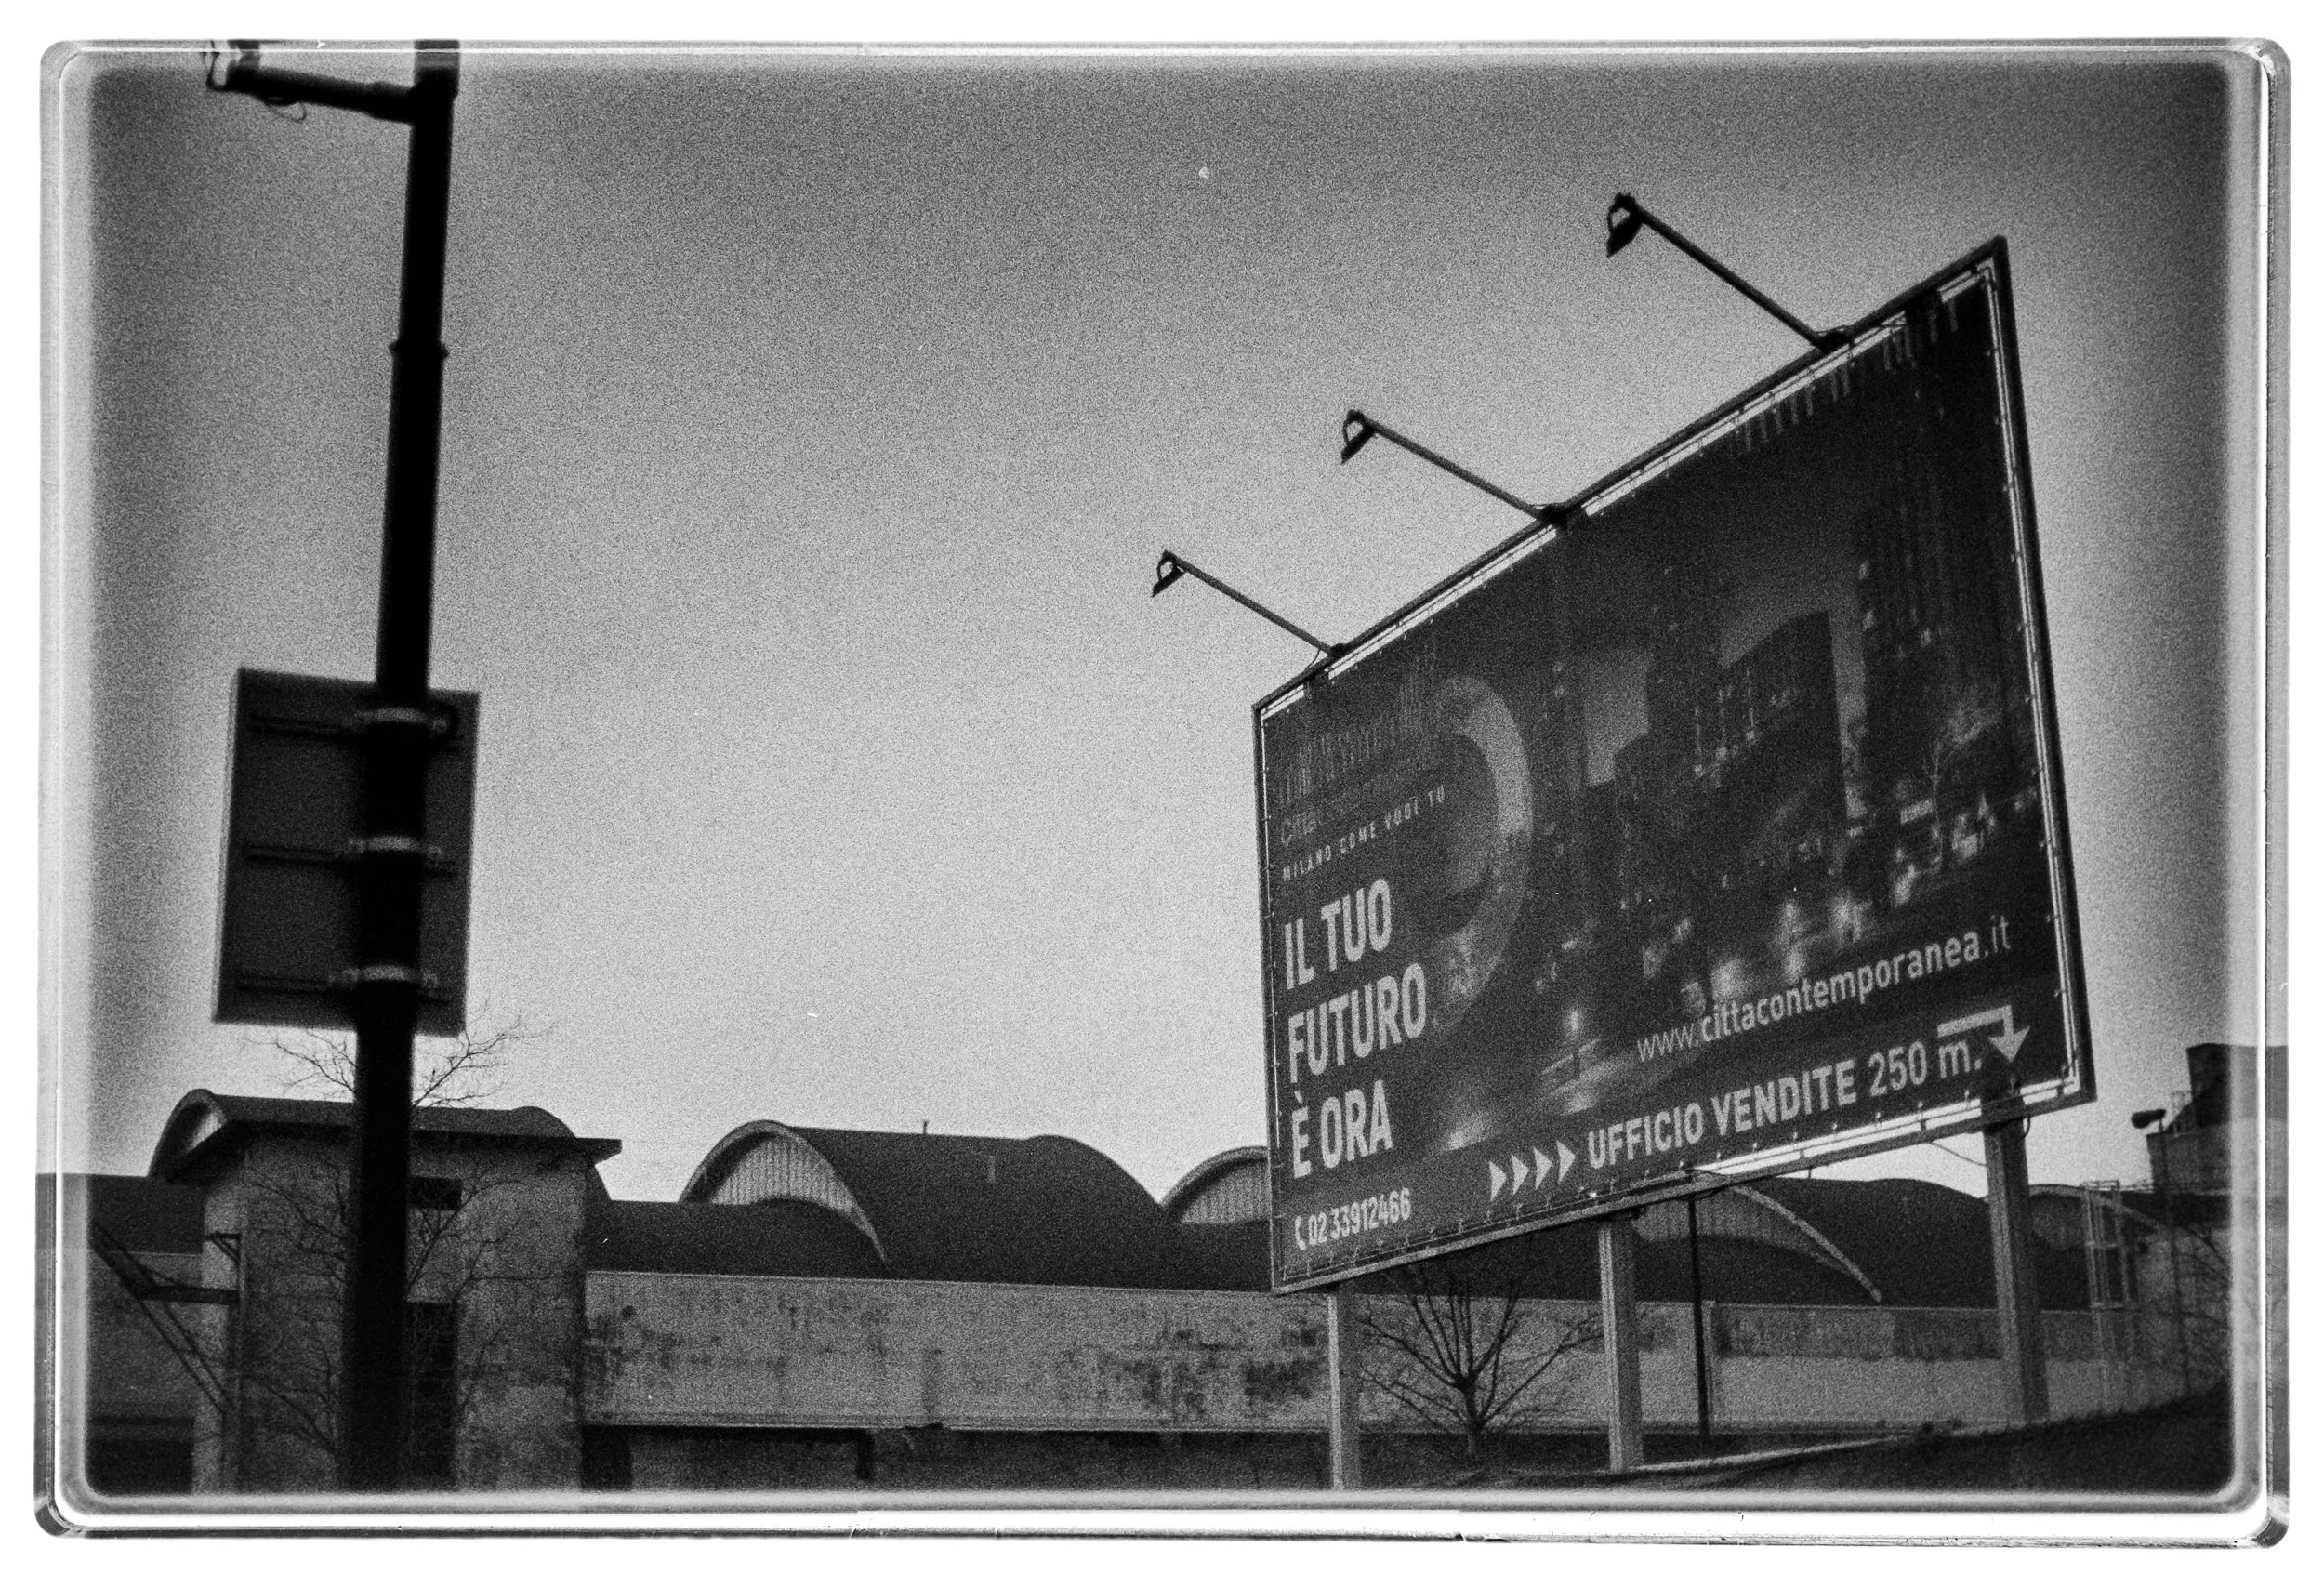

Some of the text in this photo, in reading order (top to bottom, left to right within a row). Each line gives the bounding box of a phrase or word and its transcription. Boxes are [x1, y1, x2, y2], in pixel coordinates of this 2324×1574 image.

[1283, 844, 1331, 882] MILANO
[1340, 821, 1376, 853] COME
[1428, 785, 1445, 807] TU
[1285, 878, 1392, 989] IL TUO
[1637, 914, 2011, 1062] www.cittacontemporanea.it
[1287, 962, 1426, 1083] FUTURO
[1291, 1079, 1393, 1179] È ORA
[1588, 1039, 1982, 1170] UFFICIO VENDITE 250 m.
[1309, 1212, 1327, 1246] 02
